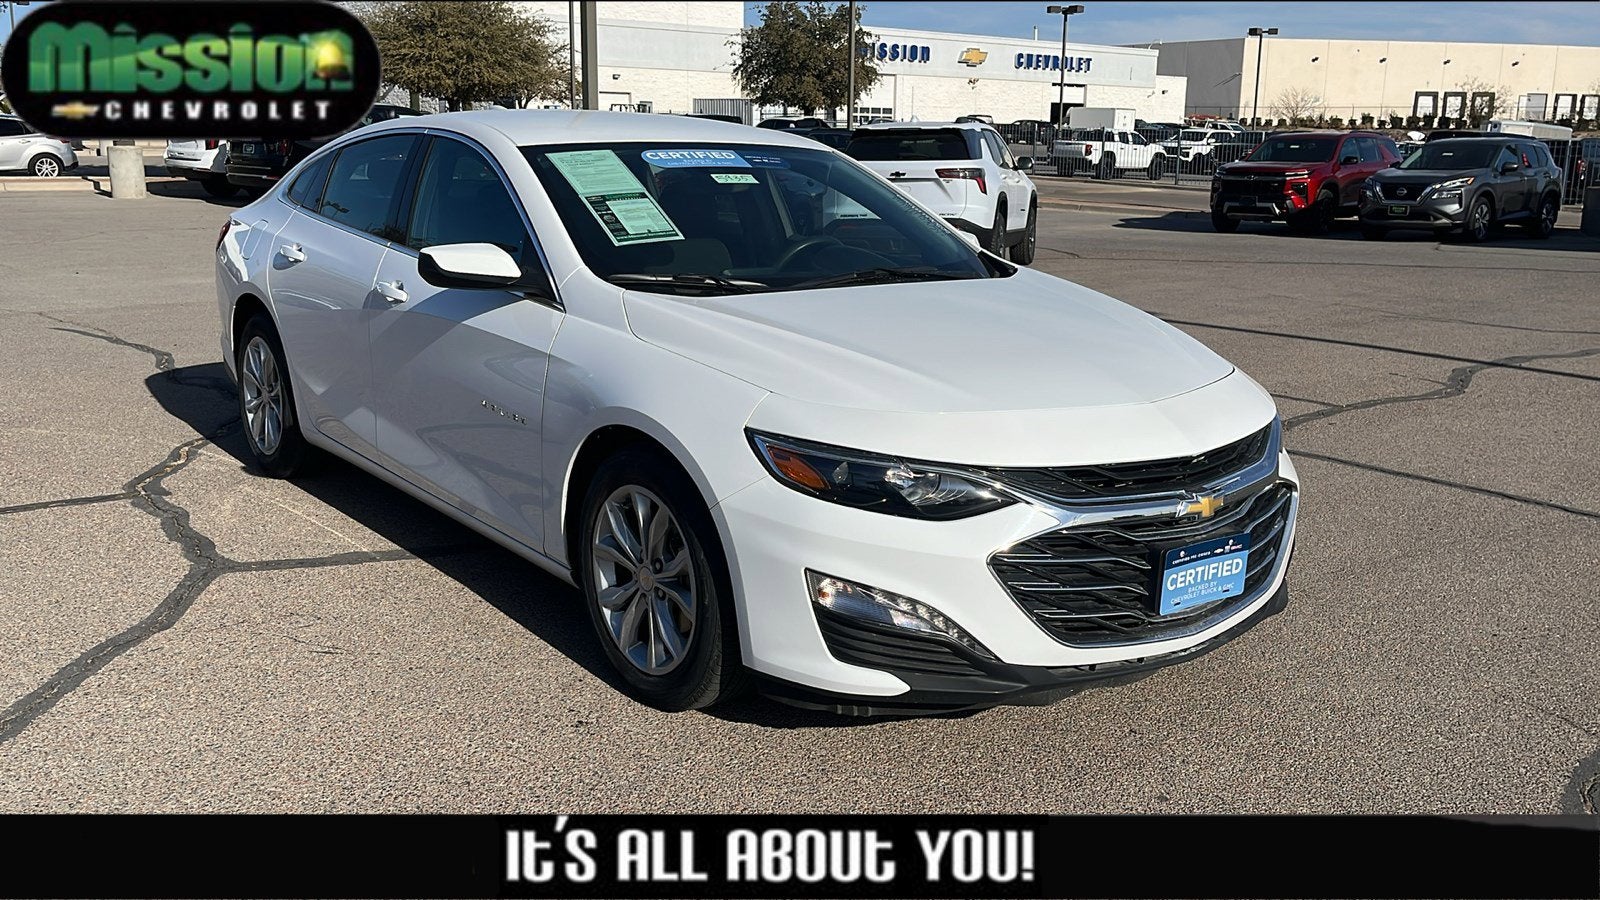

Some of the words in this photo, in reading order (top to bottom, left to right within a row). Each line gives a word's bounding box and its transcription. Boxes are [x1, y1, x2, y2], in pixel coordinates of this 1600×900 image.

[1013, 52, 1093, 74] CHEVROLET
[646, 151, 735, 159] CERTIFIED
[1167, 558, 1243, 590] CERTIFIED
[1171, 590, 1200, 604] CHEVROLET
[1201, 587, 1217, 596] BUICK
[1188, 582, 1208, 593] BACKED
